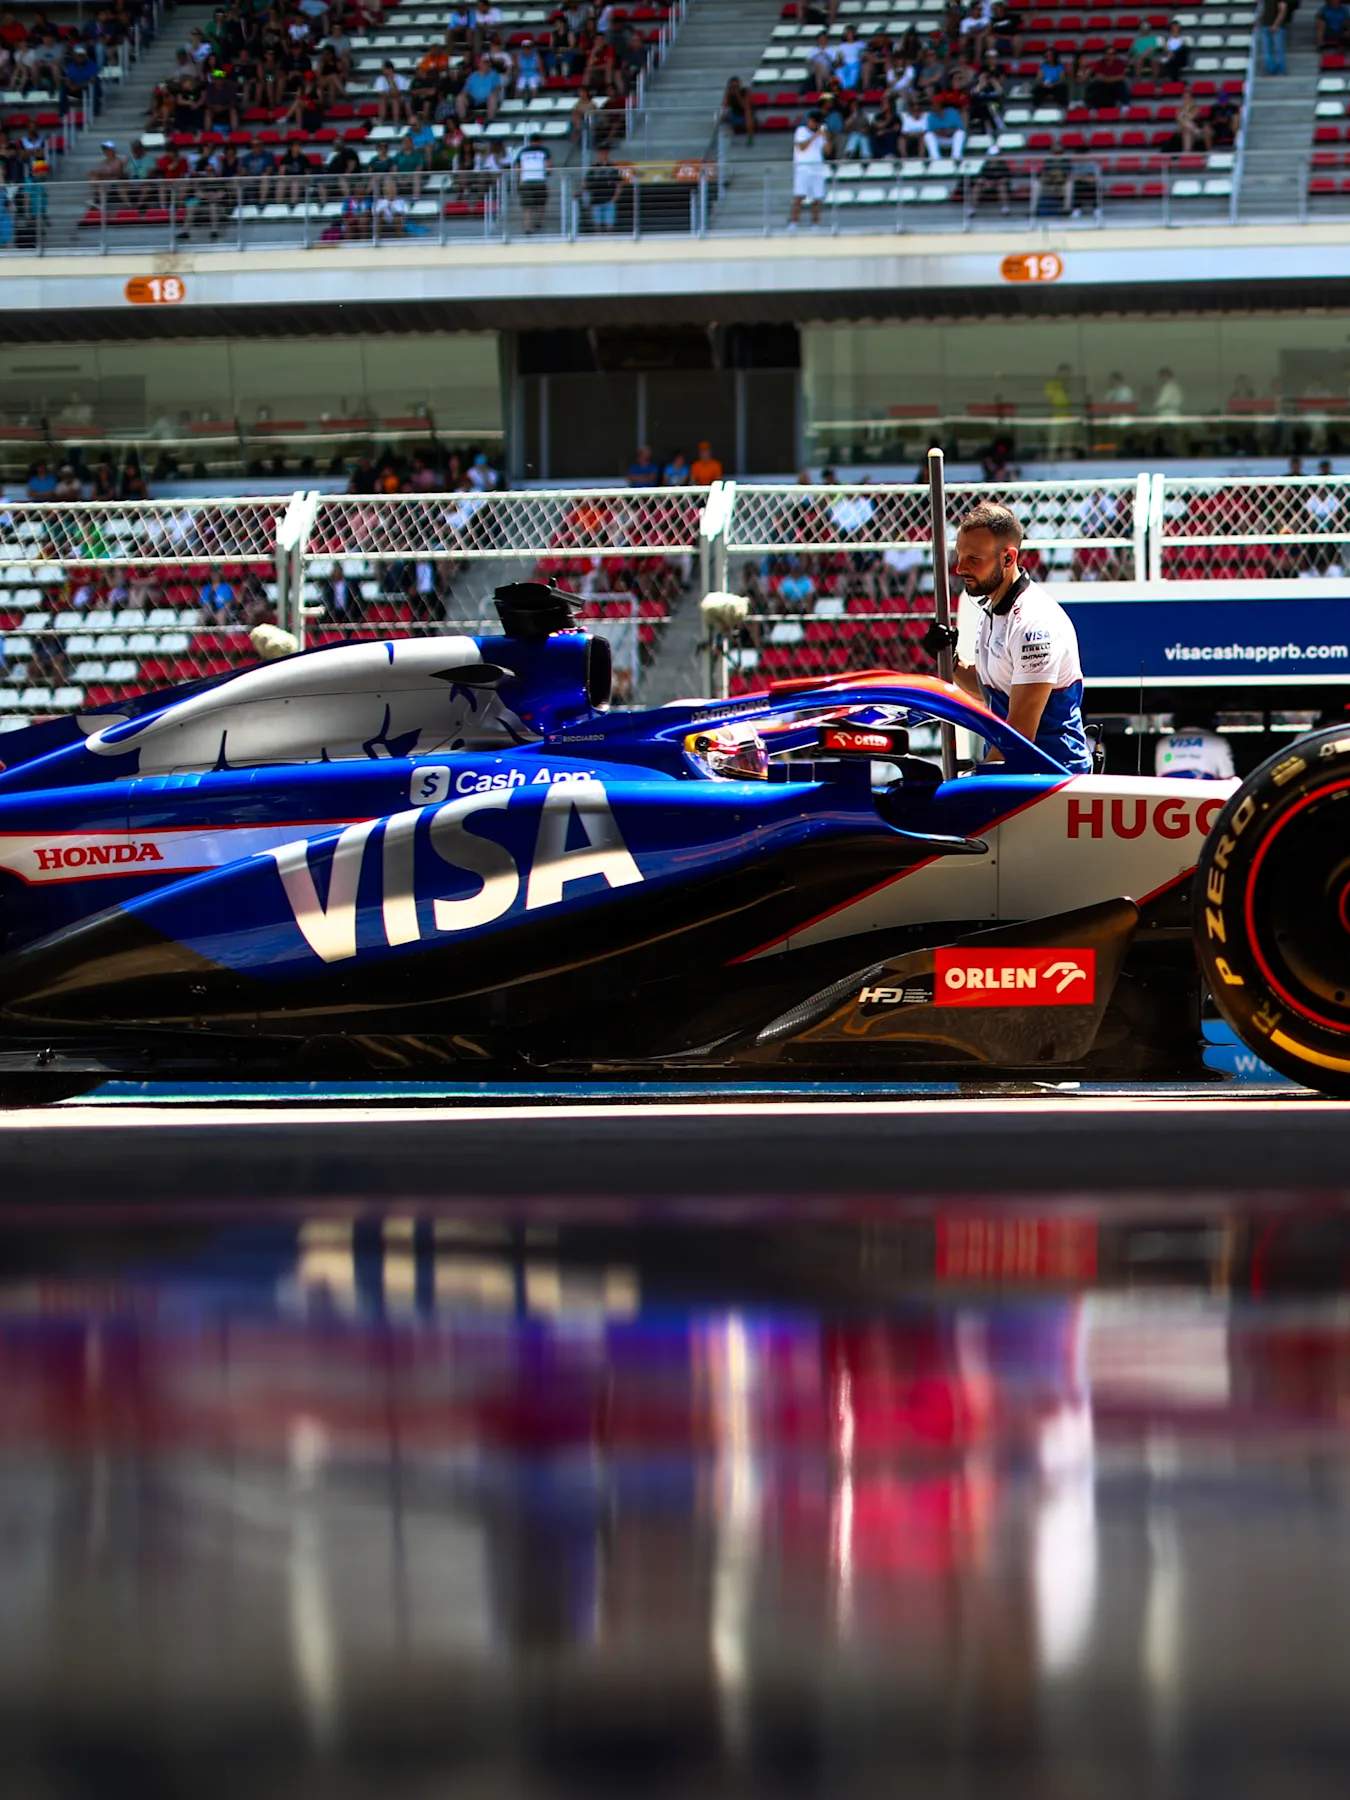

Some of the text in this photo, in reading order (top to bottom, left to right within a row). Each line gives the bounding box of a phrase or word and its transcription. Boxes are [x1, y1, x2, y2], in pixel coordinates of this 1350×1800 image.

[1023, 255, 1058, 279] 19
[147, 279, 180, 301] 18
[1025, 630, 1050, 642] VISA
[1164, 643, 1349, 663] visacashapprb.com
[563, 734, 605, 742] RICCIARDO
[854, 734, 888, 747] ORLEN
[1169, 737, 1203, 749] VISA
[455, 768, 526, 794] Cash
[33, 842, 164, 871] HONDA
[253, 779, 645, 964] VISA
[1206, 795, 1256, 945] ZERO
[945, 967, 1037, 989] ORLEN
